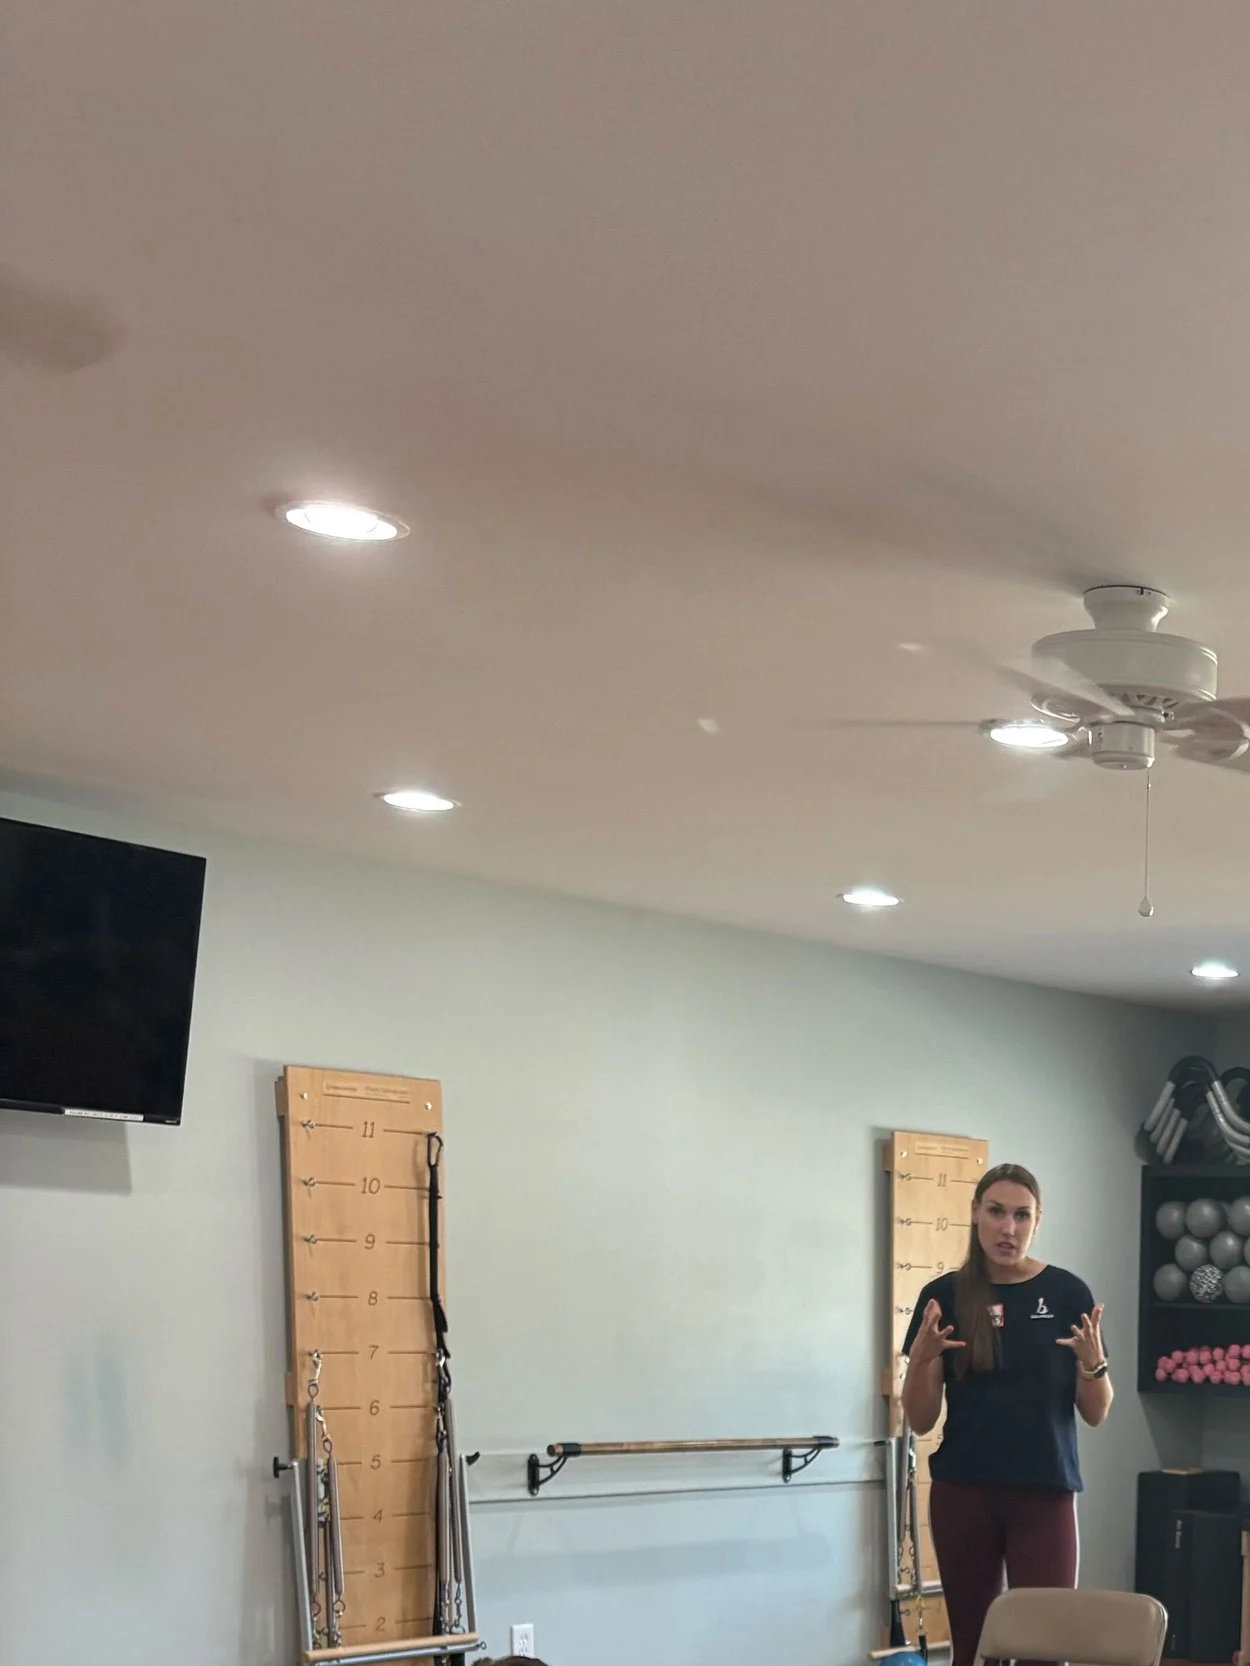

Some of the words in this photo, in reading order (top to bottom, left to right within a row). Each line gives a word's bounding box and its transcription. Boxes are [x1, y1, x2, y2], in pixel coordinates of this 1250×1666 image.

[361, 1121, 375, 1138] 11
[360, 1177, 381, 1195] 10
[936, 1173, 948, 1187] 11
[935, 1217, 949, 1231] 10
[364, 1233, 376, 1250] 9
[936, 1261, 945, 1275] 9
[367, 1291, 379, 1306] 8
[368, 1345, 379, 1360] 7
[369, 1400, 380, 1416] 6
[370, 1454, 381, 1470] 5
[372, 1509, 383, 1523] 4
[374, 1562, 385, 1578] 3
[375, 1616, 386, 1632] 2
